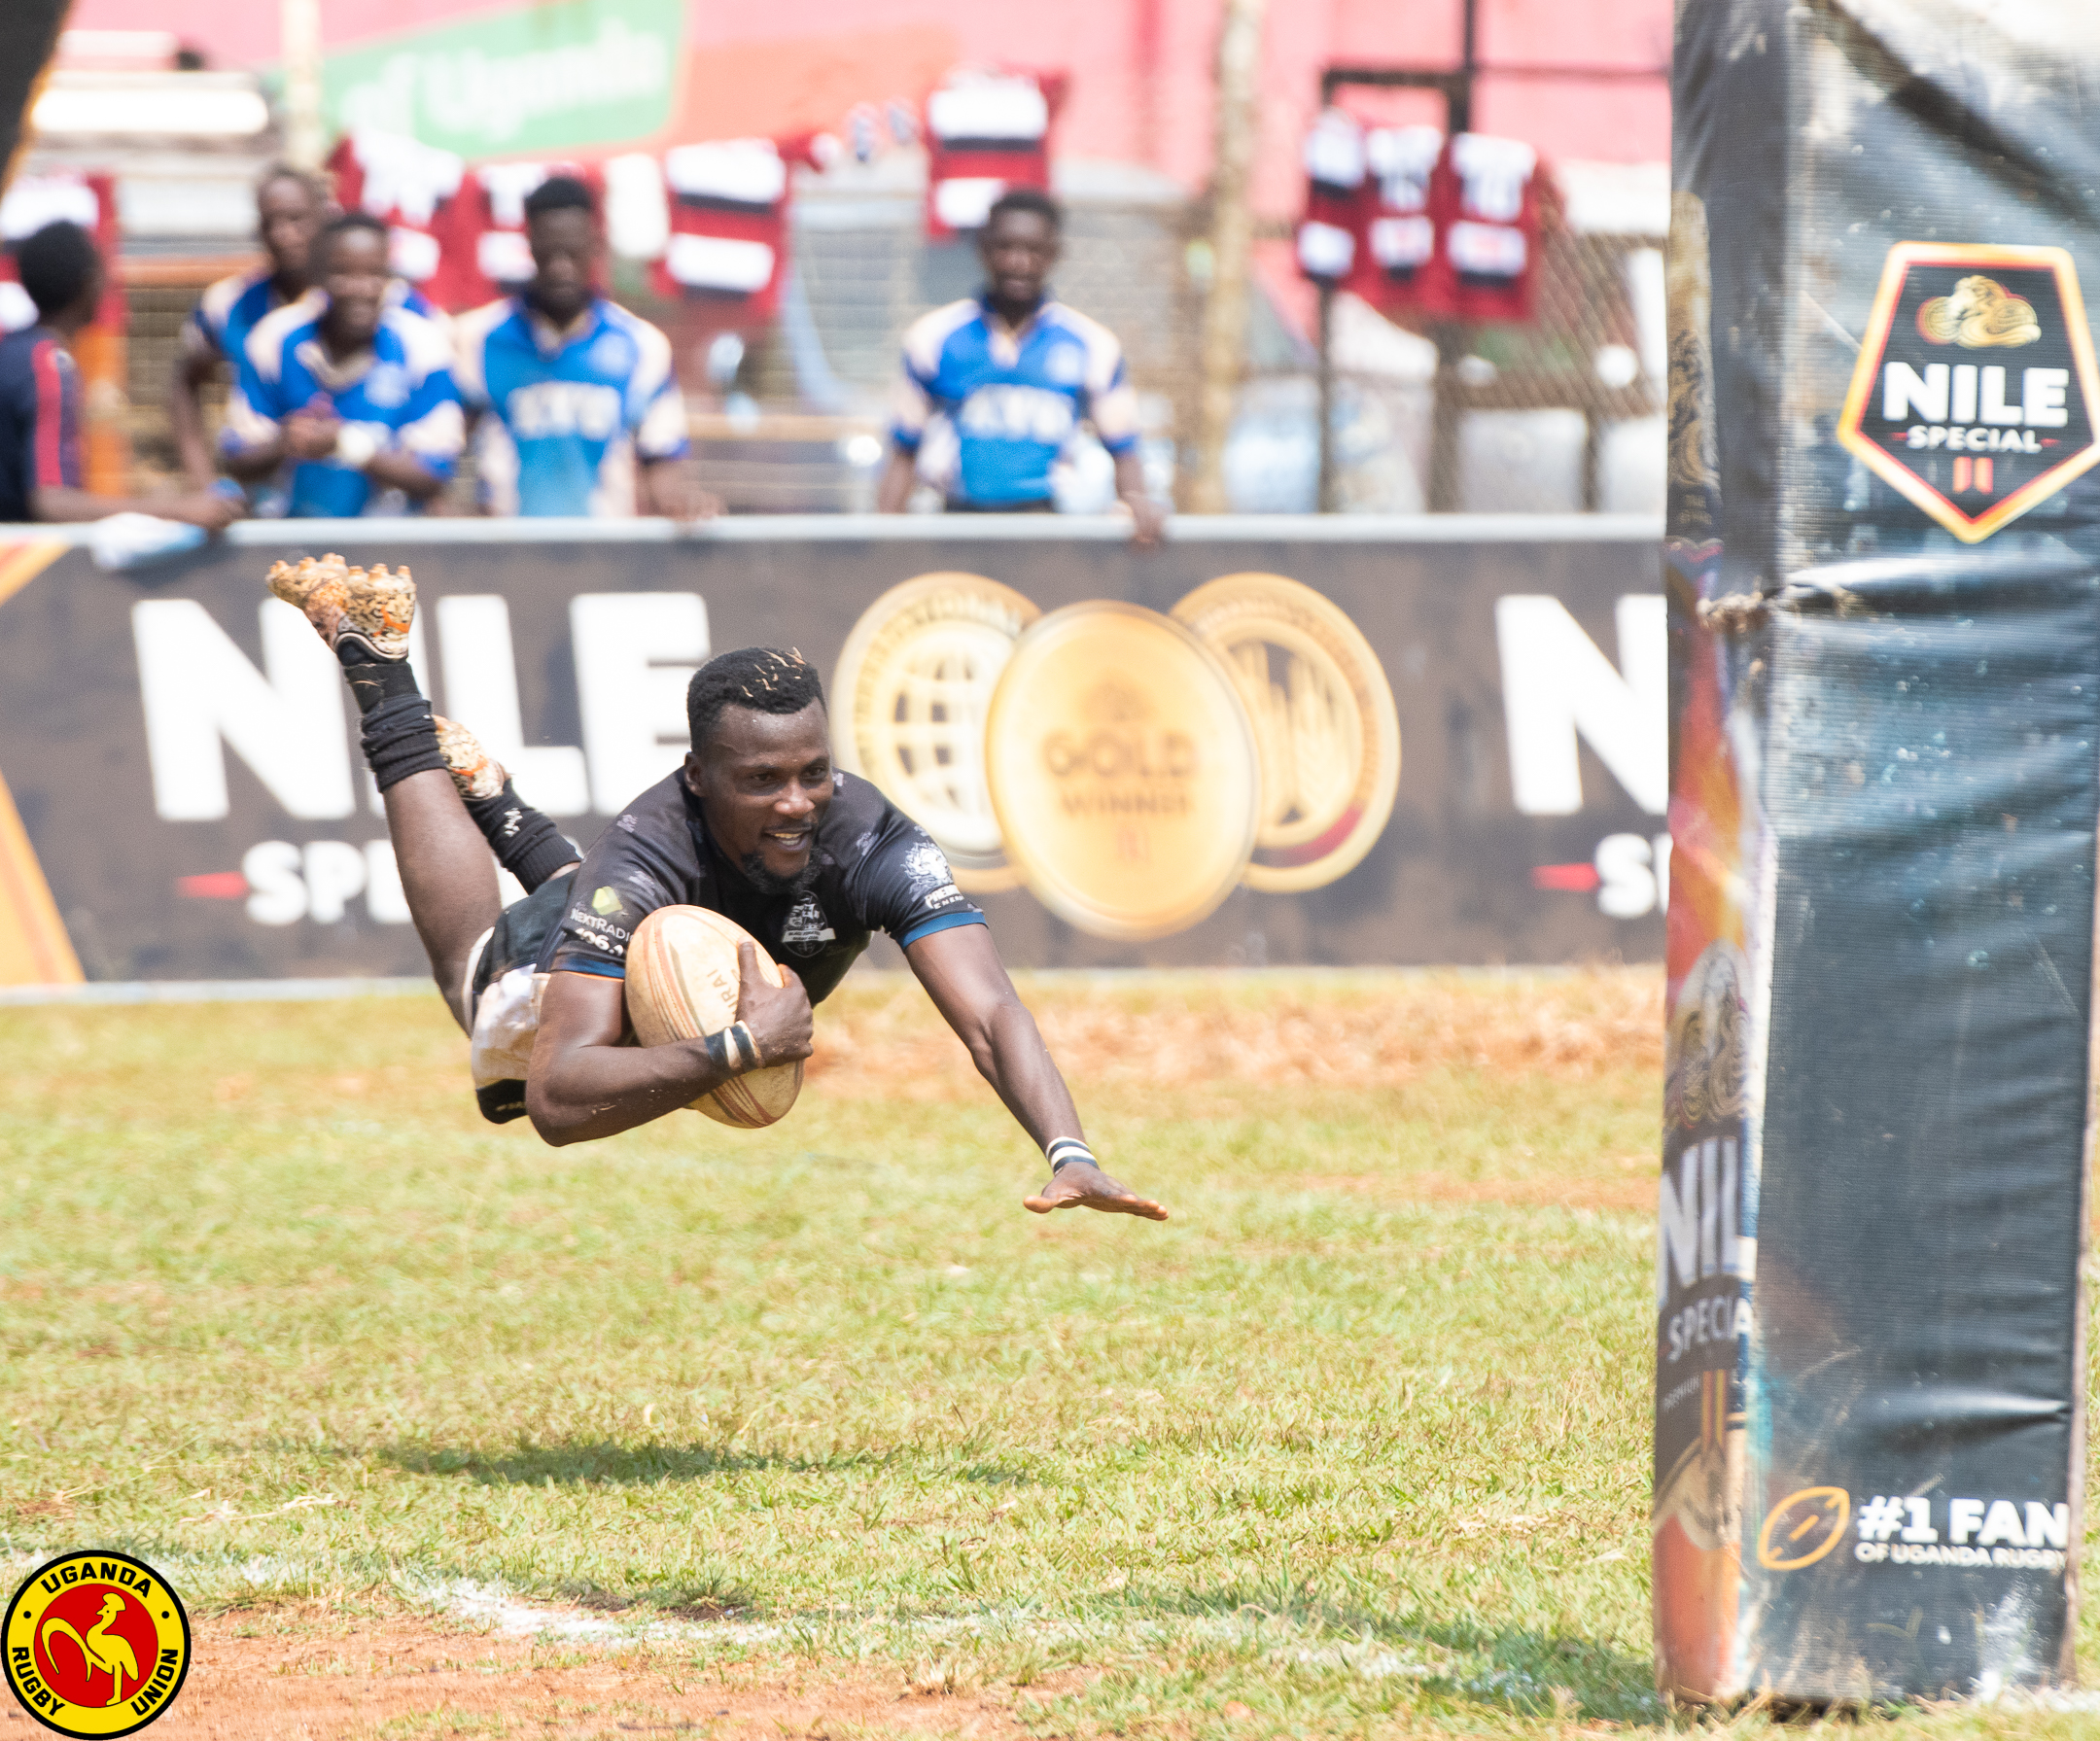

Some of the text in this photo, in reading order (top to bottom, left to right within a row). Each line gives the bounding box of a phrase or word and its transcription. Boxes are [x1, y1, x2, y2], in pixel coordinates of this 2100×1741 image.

[1882, 361, 2069, 428] NILE
[1907, 425, 2042, 454] SPECIAL
[1043, 731, 1198, 780] GOLD
[1857, 1495, 2070, 1549] #1 FAN
[1854, 1542, 1890, 1563] OF
[1890, 1544, 1993, 1568] UGANDA
